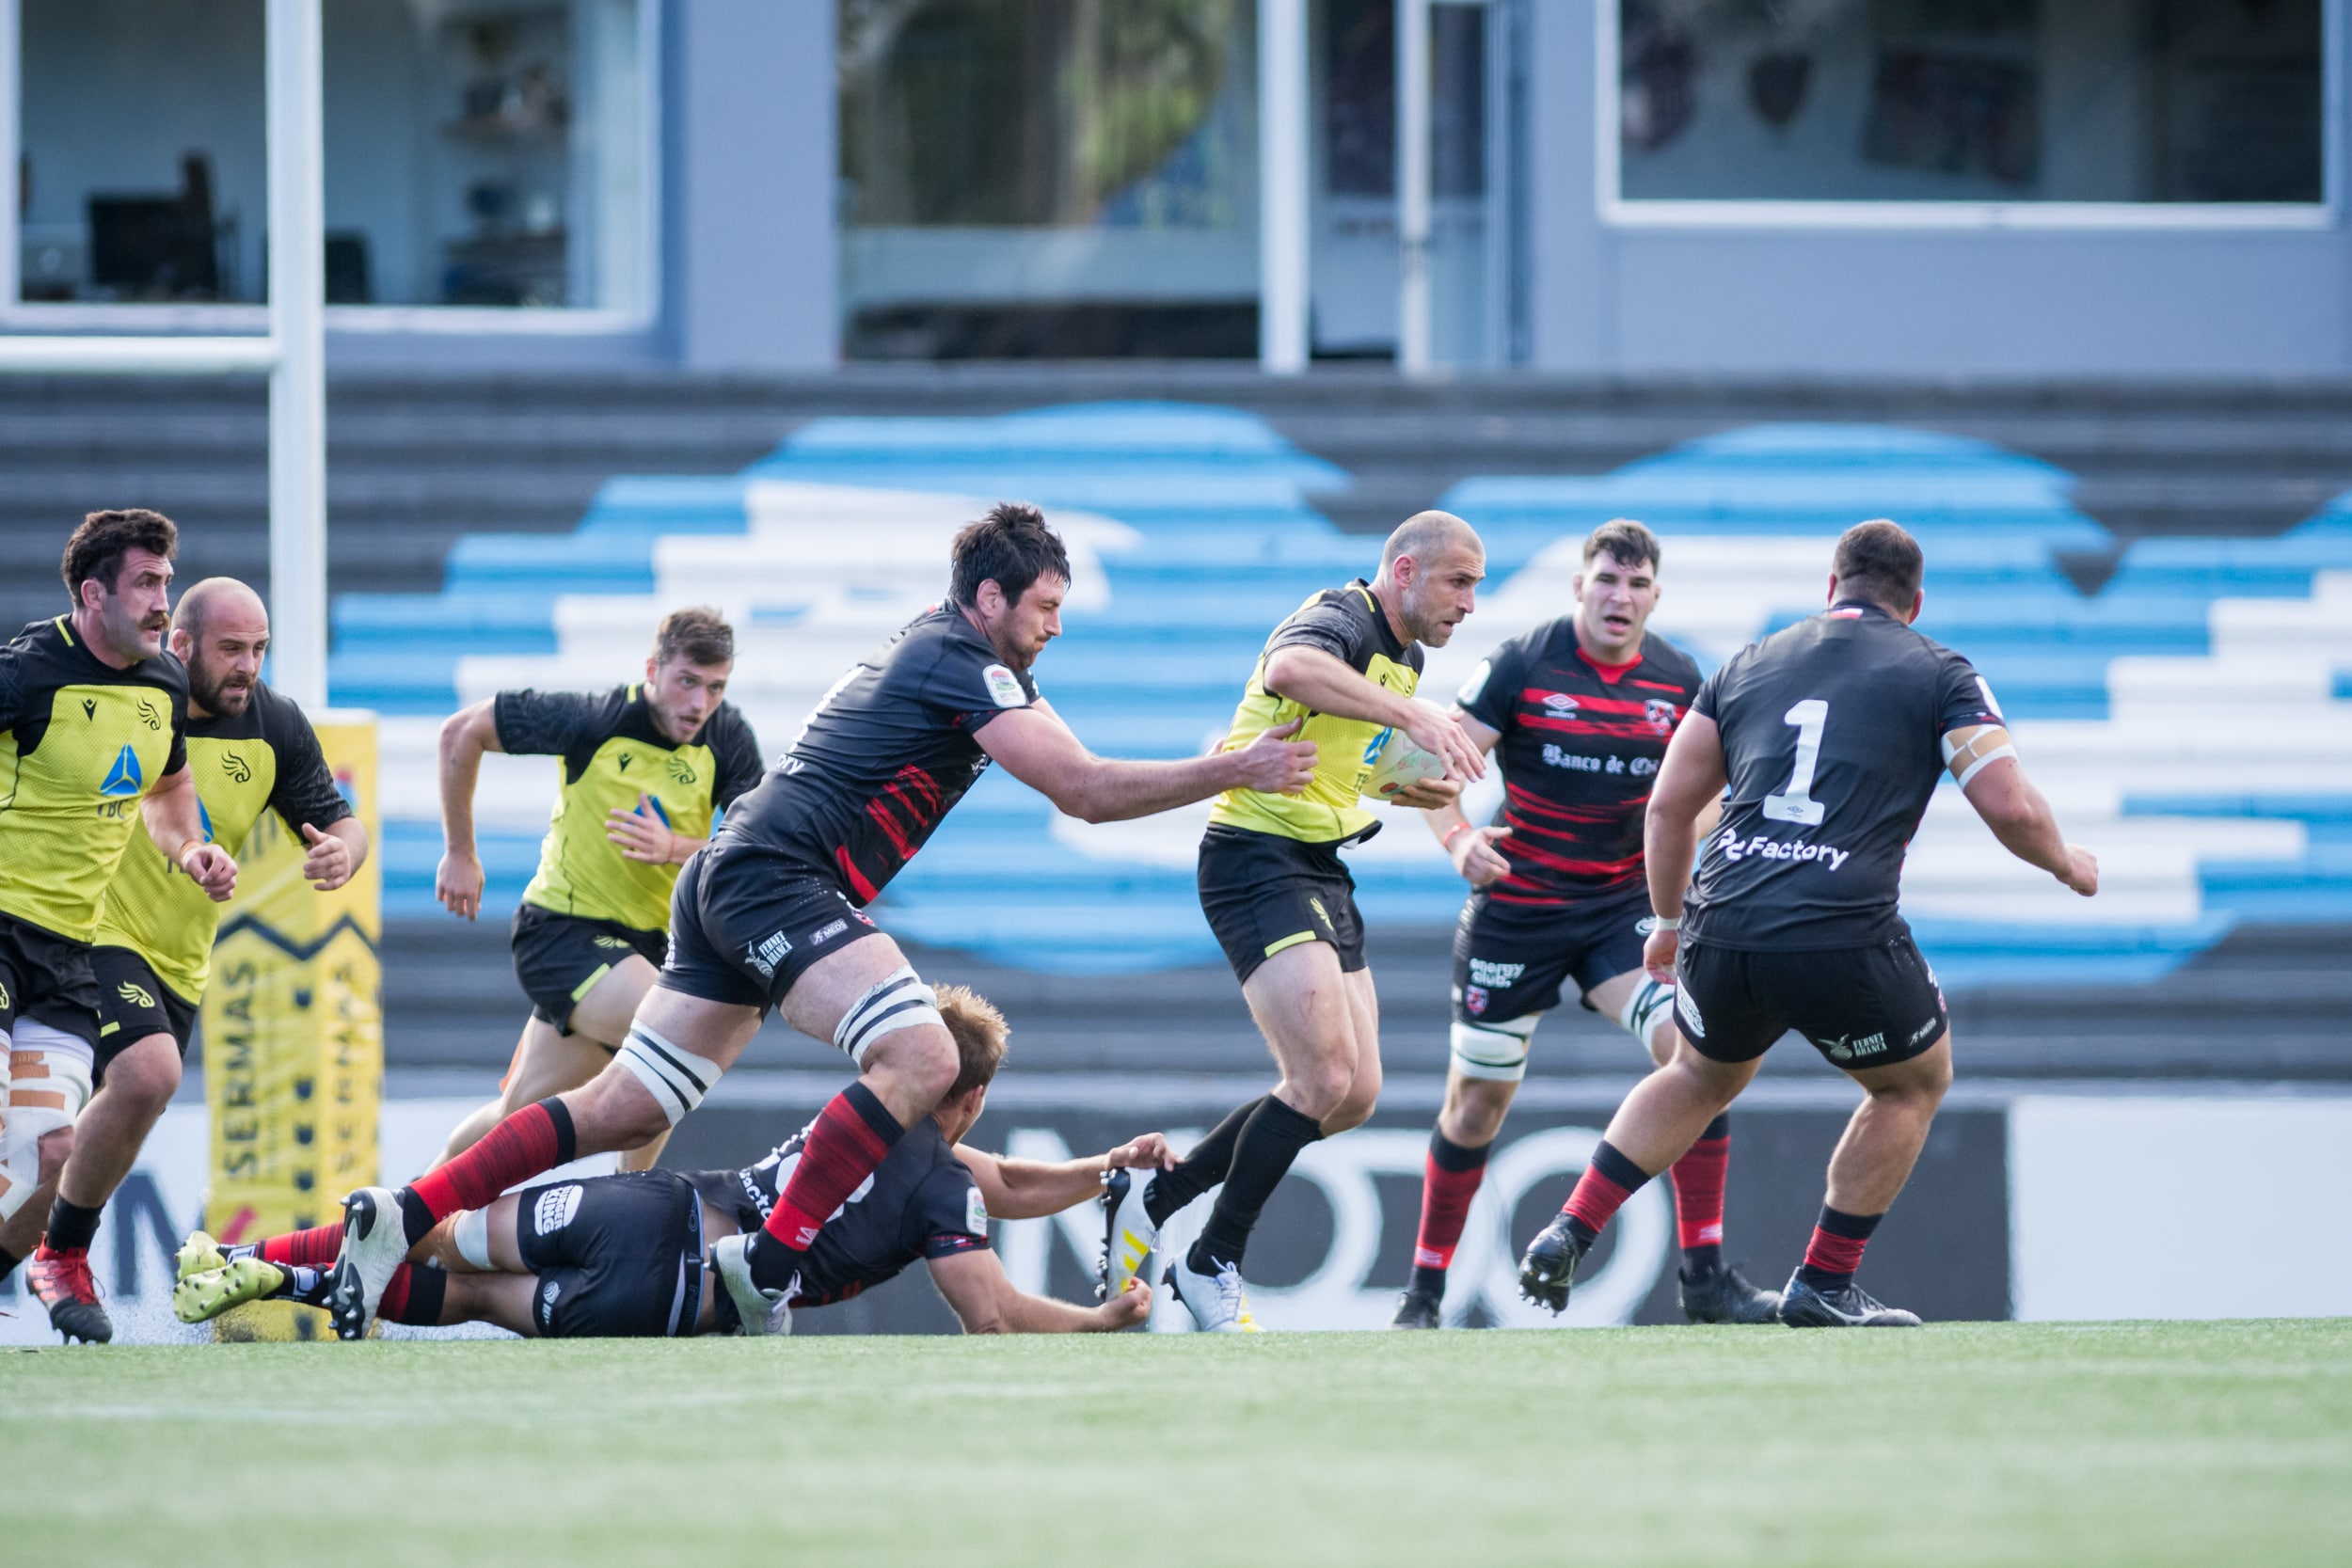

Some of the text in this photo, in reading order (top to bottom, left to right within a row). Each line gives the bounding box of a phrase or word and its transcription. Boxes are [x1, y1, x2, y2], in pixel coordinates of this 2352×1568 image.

[1542, 743, 1601, 772] Banco
[1605, 755, 1626, 774] de
[1763, 699, 1828, 826] 1
[1746, 836, 1850, 872] Factory
[758, 930, 787, 957] FERNET
[1470, 958, 1526, 979] energy
[221, 961, 259, 1179] SERMAS
[543, 1187, 564, 1234] KING
[554, 1185, 574, 1230] BURGER
